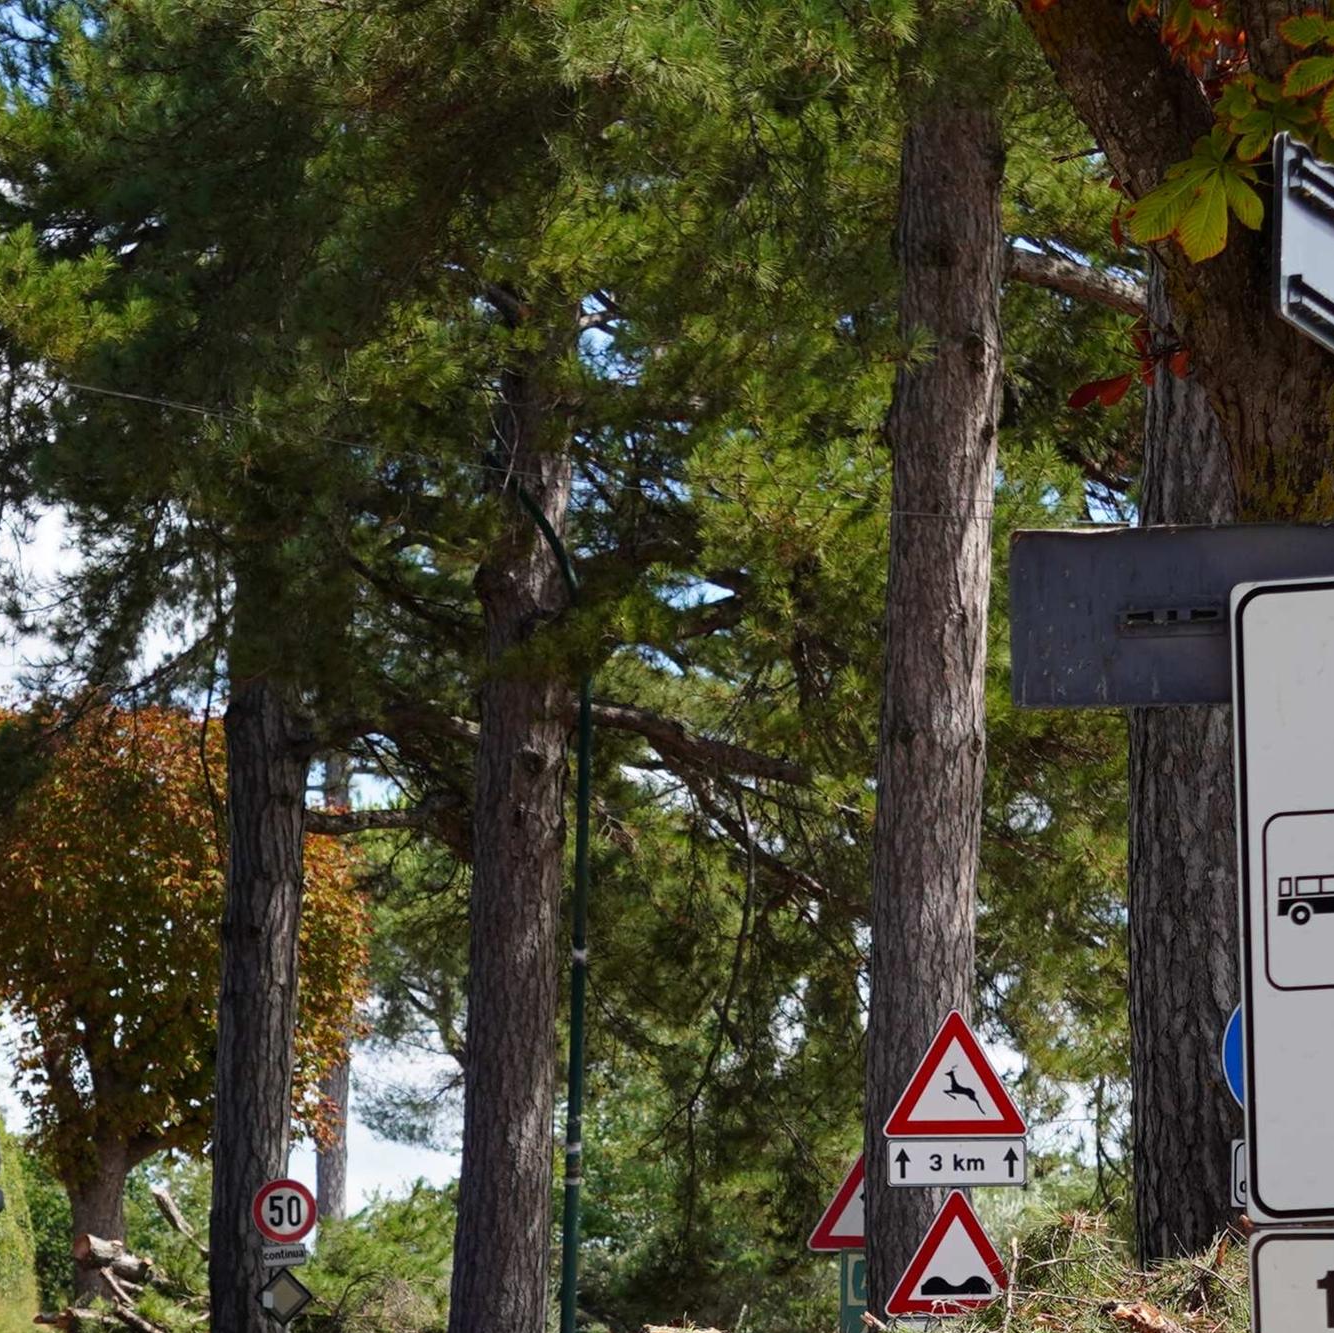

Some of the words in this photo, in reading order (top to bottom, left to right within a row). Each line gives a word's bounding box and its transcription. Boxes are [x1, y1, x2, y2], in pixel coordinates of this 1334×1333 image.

[929, 1153, 942, 1171] 3
[953, 1153, 985, 1171] km
[269, 1195, 301, 1227] 50
[263, 1248, 305, 1260] continua
